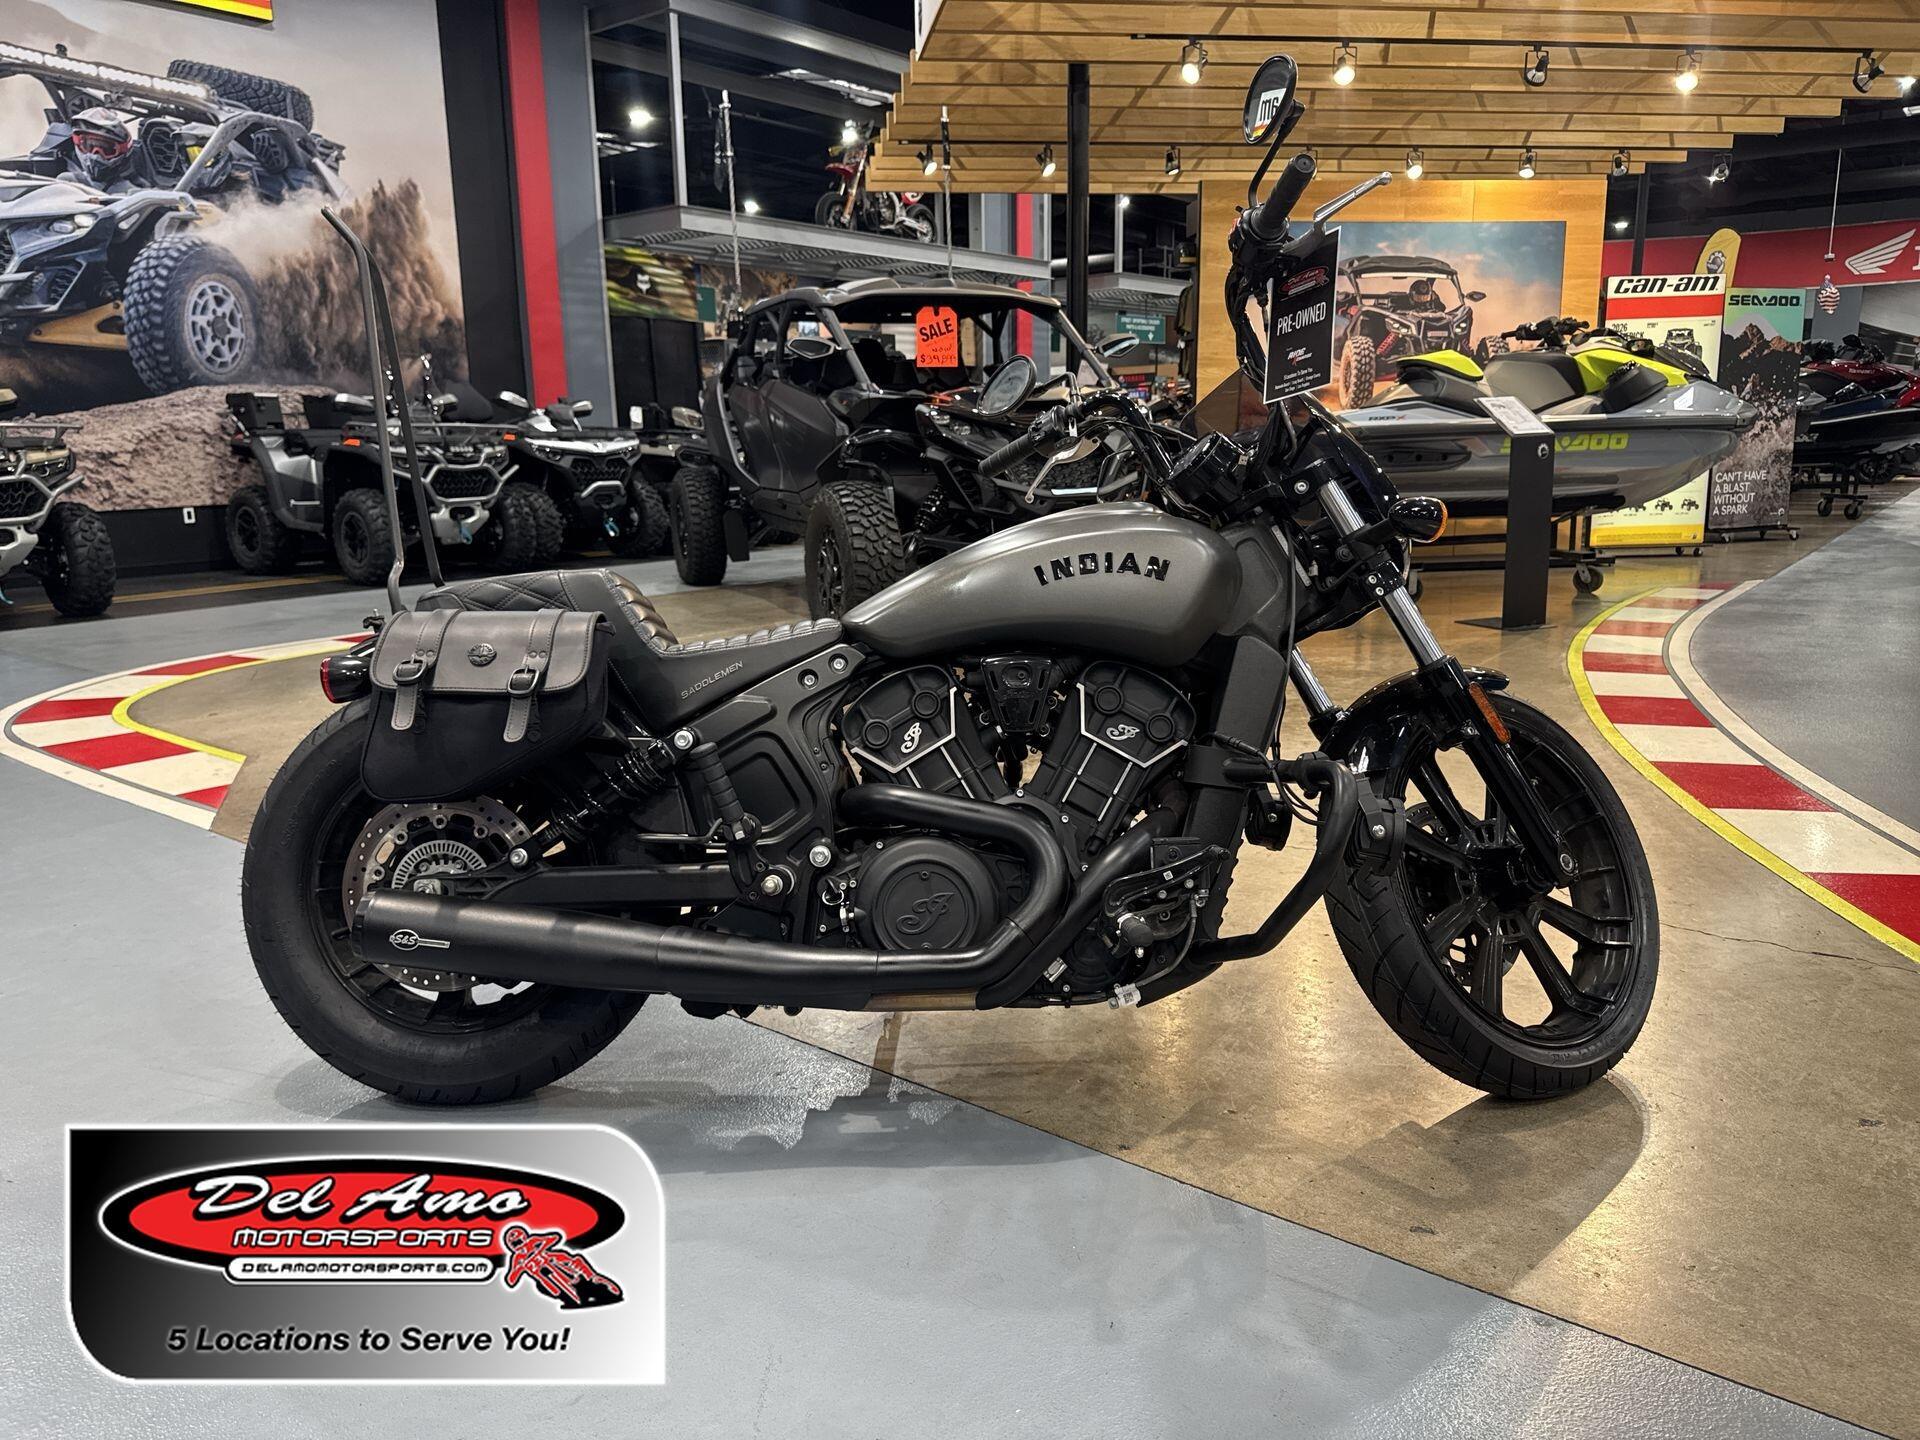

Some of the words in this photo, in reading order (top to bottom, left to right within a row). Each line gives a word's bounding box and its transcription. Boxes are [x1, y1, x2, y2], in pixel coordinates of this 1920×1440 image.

[1613, 275, 1720, 294] can-am
[1276, 301, 1327, 336] PRE-OWNED
[919, 317, 954, 342] SALE
[1715, 471, 1742, 483] CAN'T
[1743, 470, 1767, 481] HAVE
[1714, 484, 1721, 494] A
[1723, 482, 1750, 493] BLAST
[1713, 492, 1756, 504] WITHOUT
[1712, 506, 1719, 516] A
[1721, 504, 1748, 515] SPARK
[1033, 551, 1172, 587] INDIAN
[680, 660, 744, 699] SADDLEMEN
[393, 934, 417, 945] S&S
